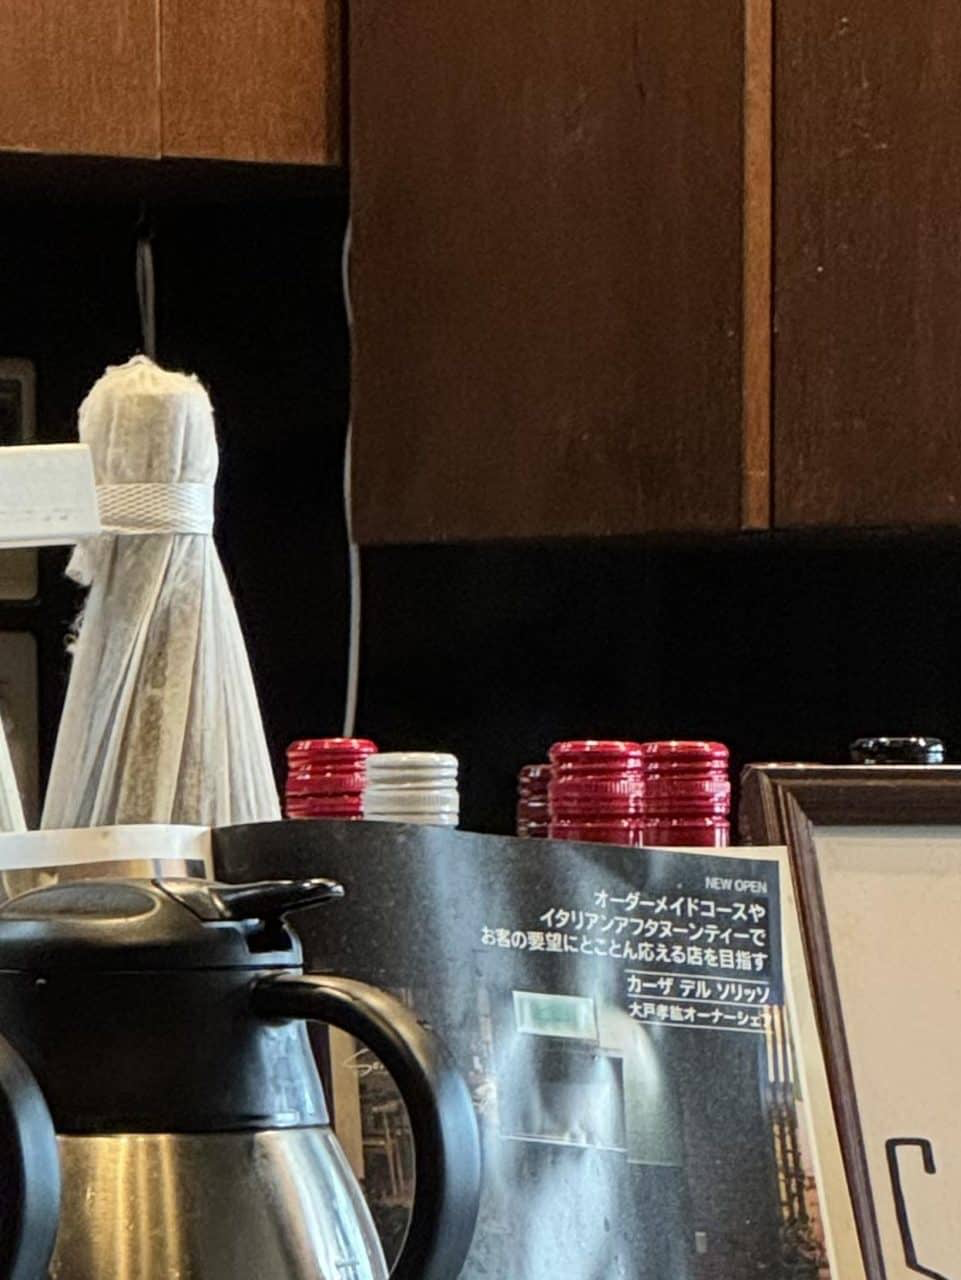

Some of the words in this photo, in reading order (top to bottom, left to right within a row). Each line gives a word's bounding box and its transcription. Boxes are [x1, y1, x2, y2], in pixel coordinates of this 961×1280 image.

[705, 876, 733, 891] NEW
[734, 879, 768, 894] OPEN
[594, 889, 766, 923] オーダーメイドコースや
[540, 908, 767, 947] イタリアンアフタヌーンティーで
[627, 974, 674, 996] カーザ
[680, 979, 711, 999] デル
[716, 982, 770, 1004] ソリッソ
